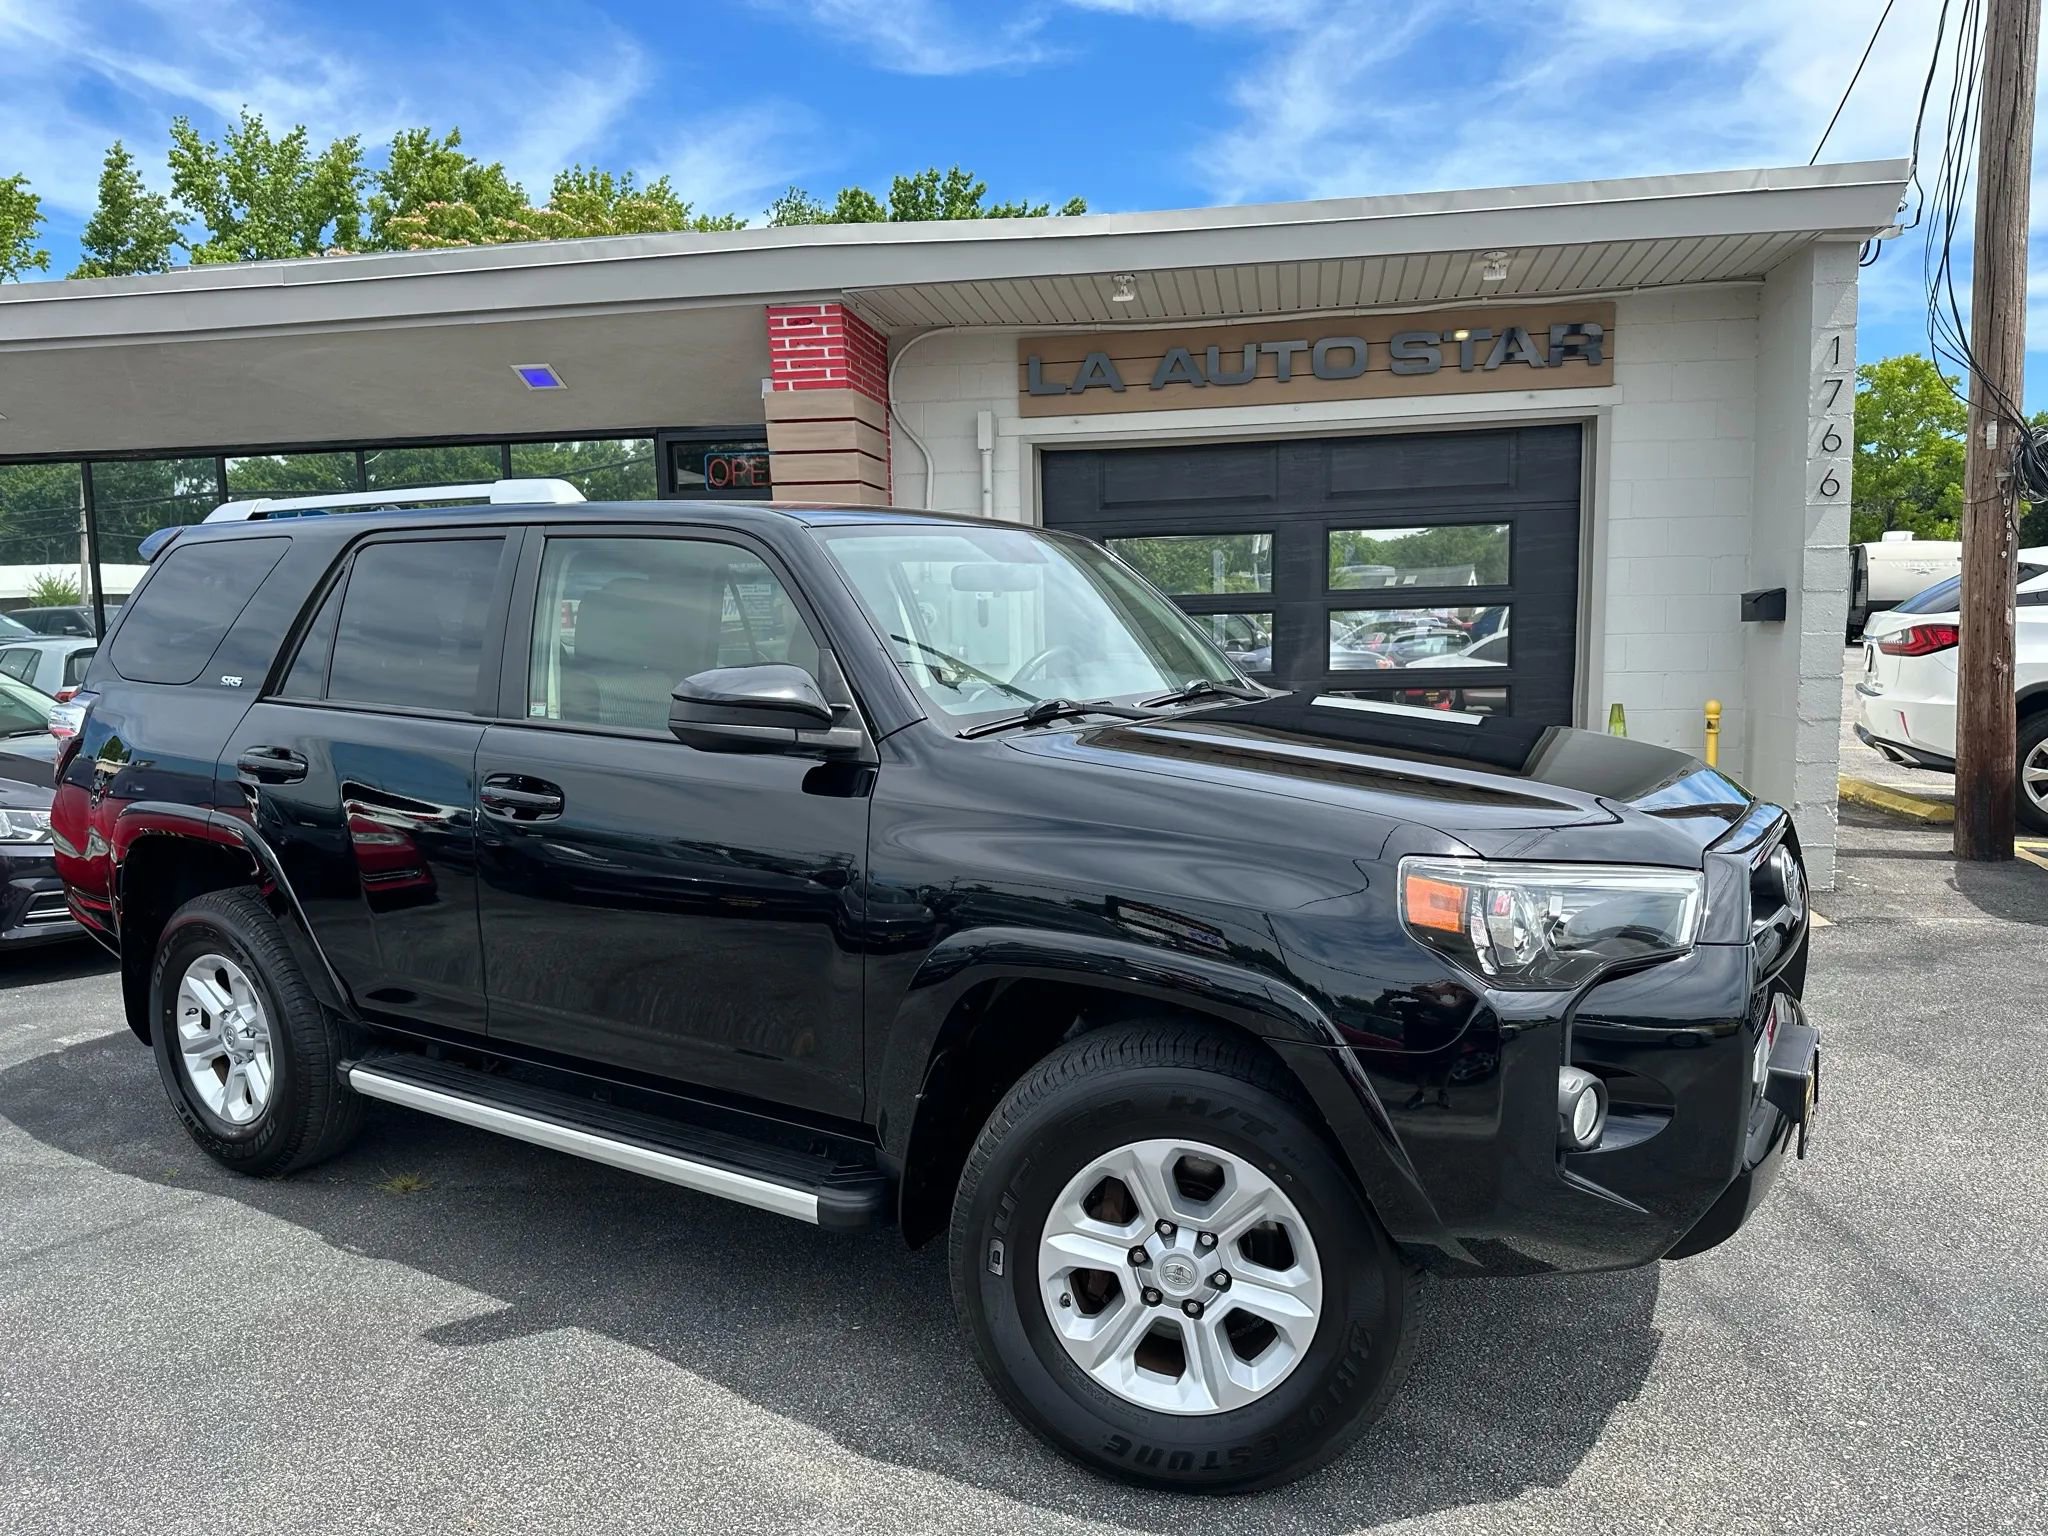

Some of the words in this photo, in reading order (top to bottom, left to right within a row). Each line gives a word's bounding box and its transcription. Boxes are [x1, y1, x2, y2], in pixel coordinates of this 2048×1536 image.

[1027, 352, 1125, 396] LA
[1149, 335, 1368, 391] AUTO
[1389, 322, 1605, 376] STAR
[708, 456, 772, 487] OPE
